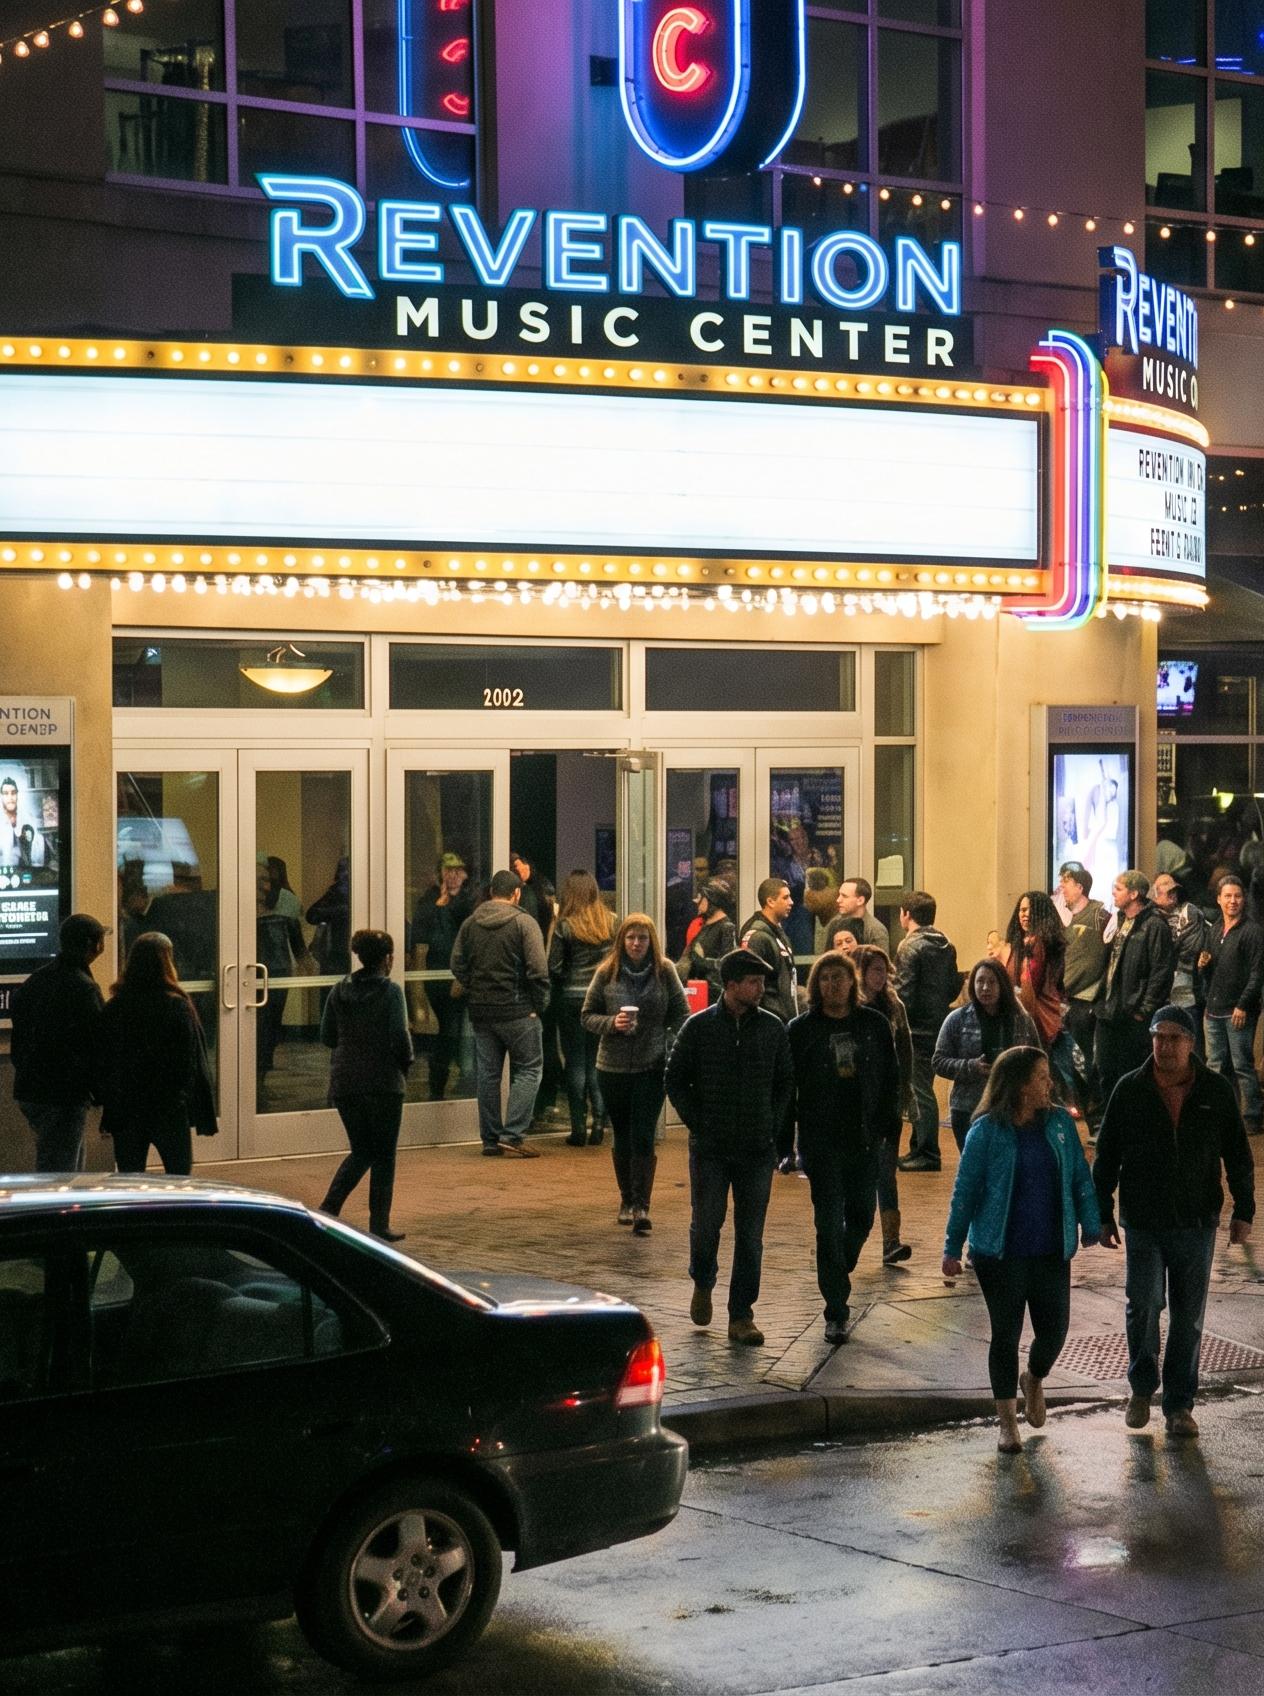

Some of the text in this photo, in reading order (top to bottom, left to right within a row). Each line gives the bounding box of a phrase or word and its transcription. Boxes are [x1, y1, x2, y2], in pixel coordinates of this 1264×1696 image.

[254, 173, 963, 316] REVENTION
[396, 295, 955, 367] MUSIC CENTER
[1142, 356, 1187, 403] MUSIC
[483, 687, 525, 707] 2002
